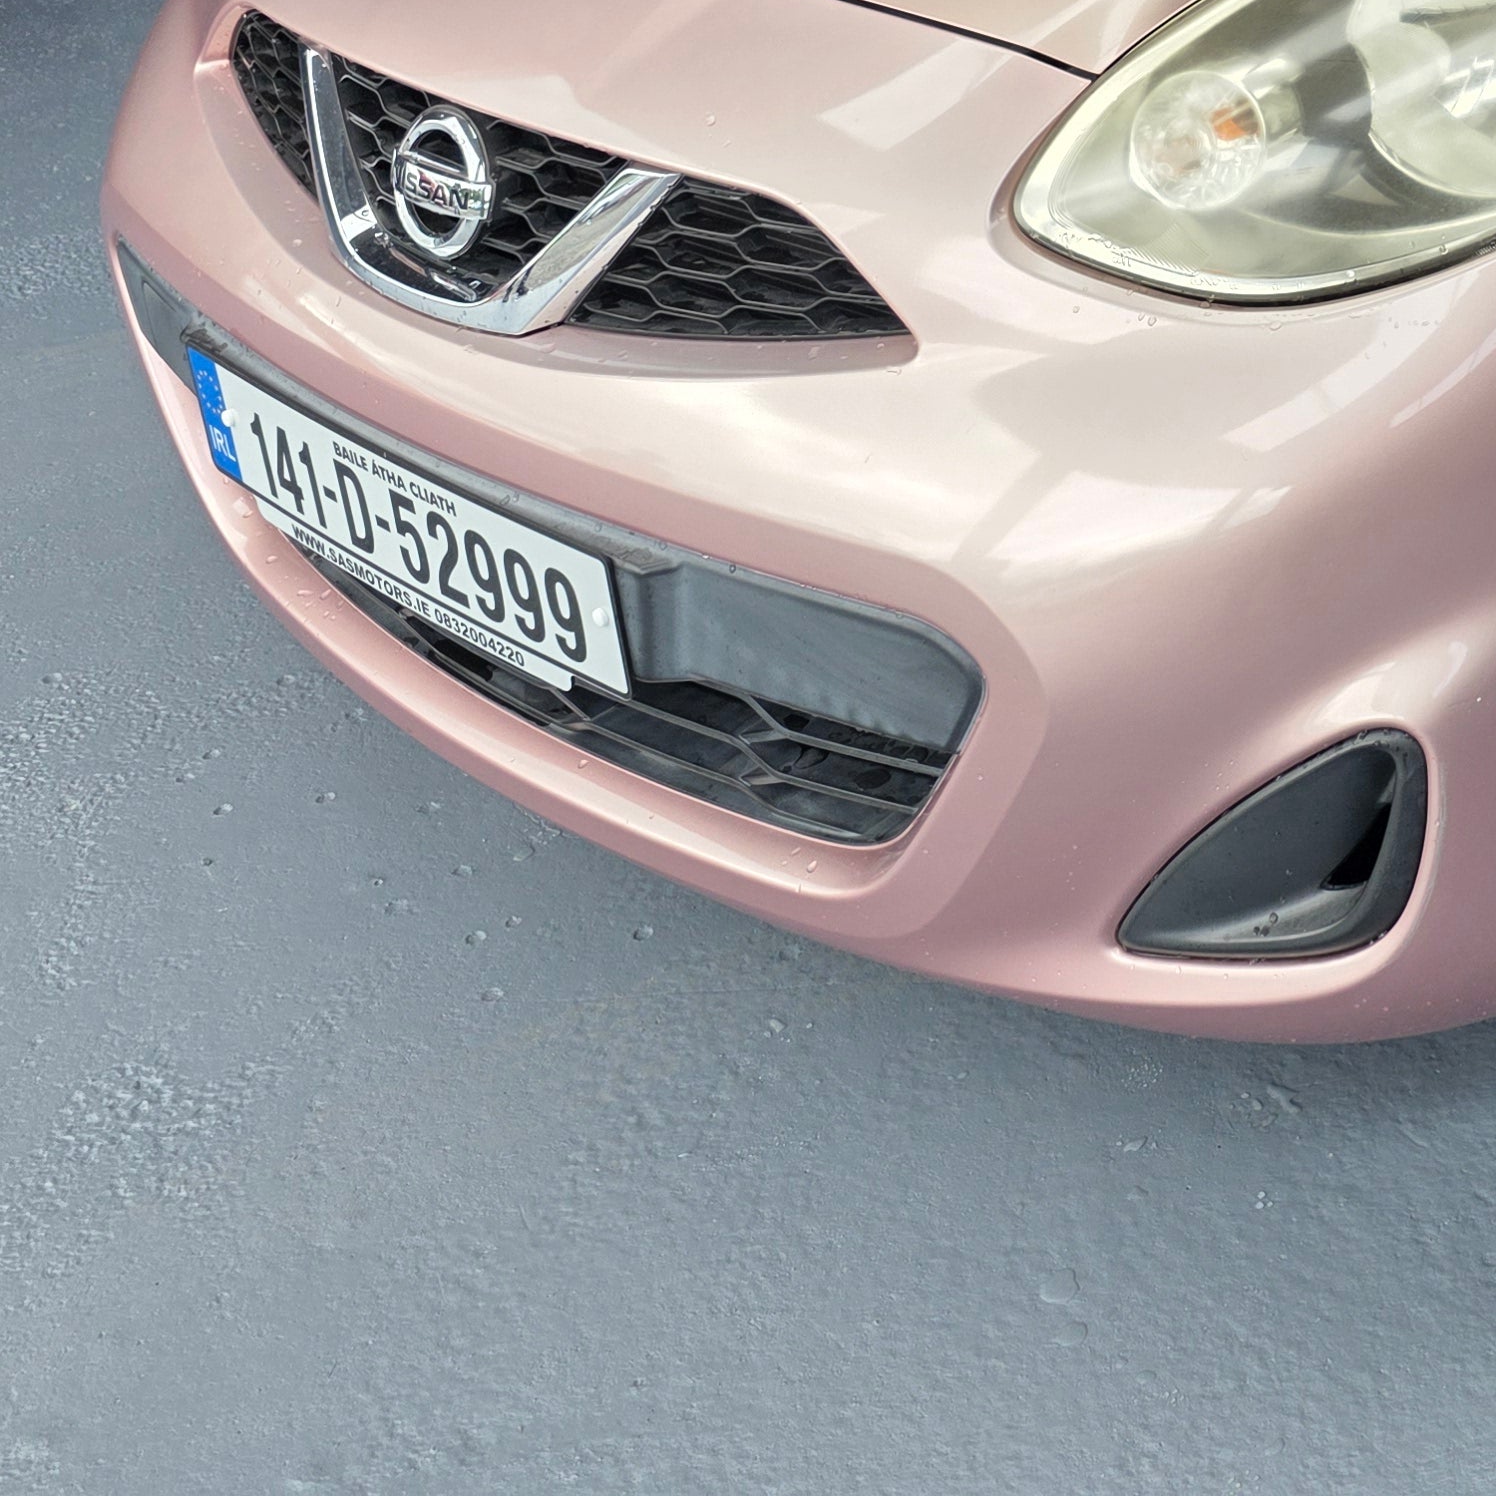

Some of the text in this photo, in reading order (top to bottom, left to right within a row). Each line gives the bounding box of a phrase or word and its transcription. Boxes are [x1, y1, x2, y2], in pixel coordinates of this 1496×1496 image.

[396, 160, 469, 210] SSAN
[208, 423, 236, 463] IRL
[332, 440, 369, 471] BAILE
[409, 481, 457, 517] CLIATH
[250, 412, 587, 663] 141-D-52999
[292, 523, 525, 667] WWW.SASMOTORS.IE 0832004220
